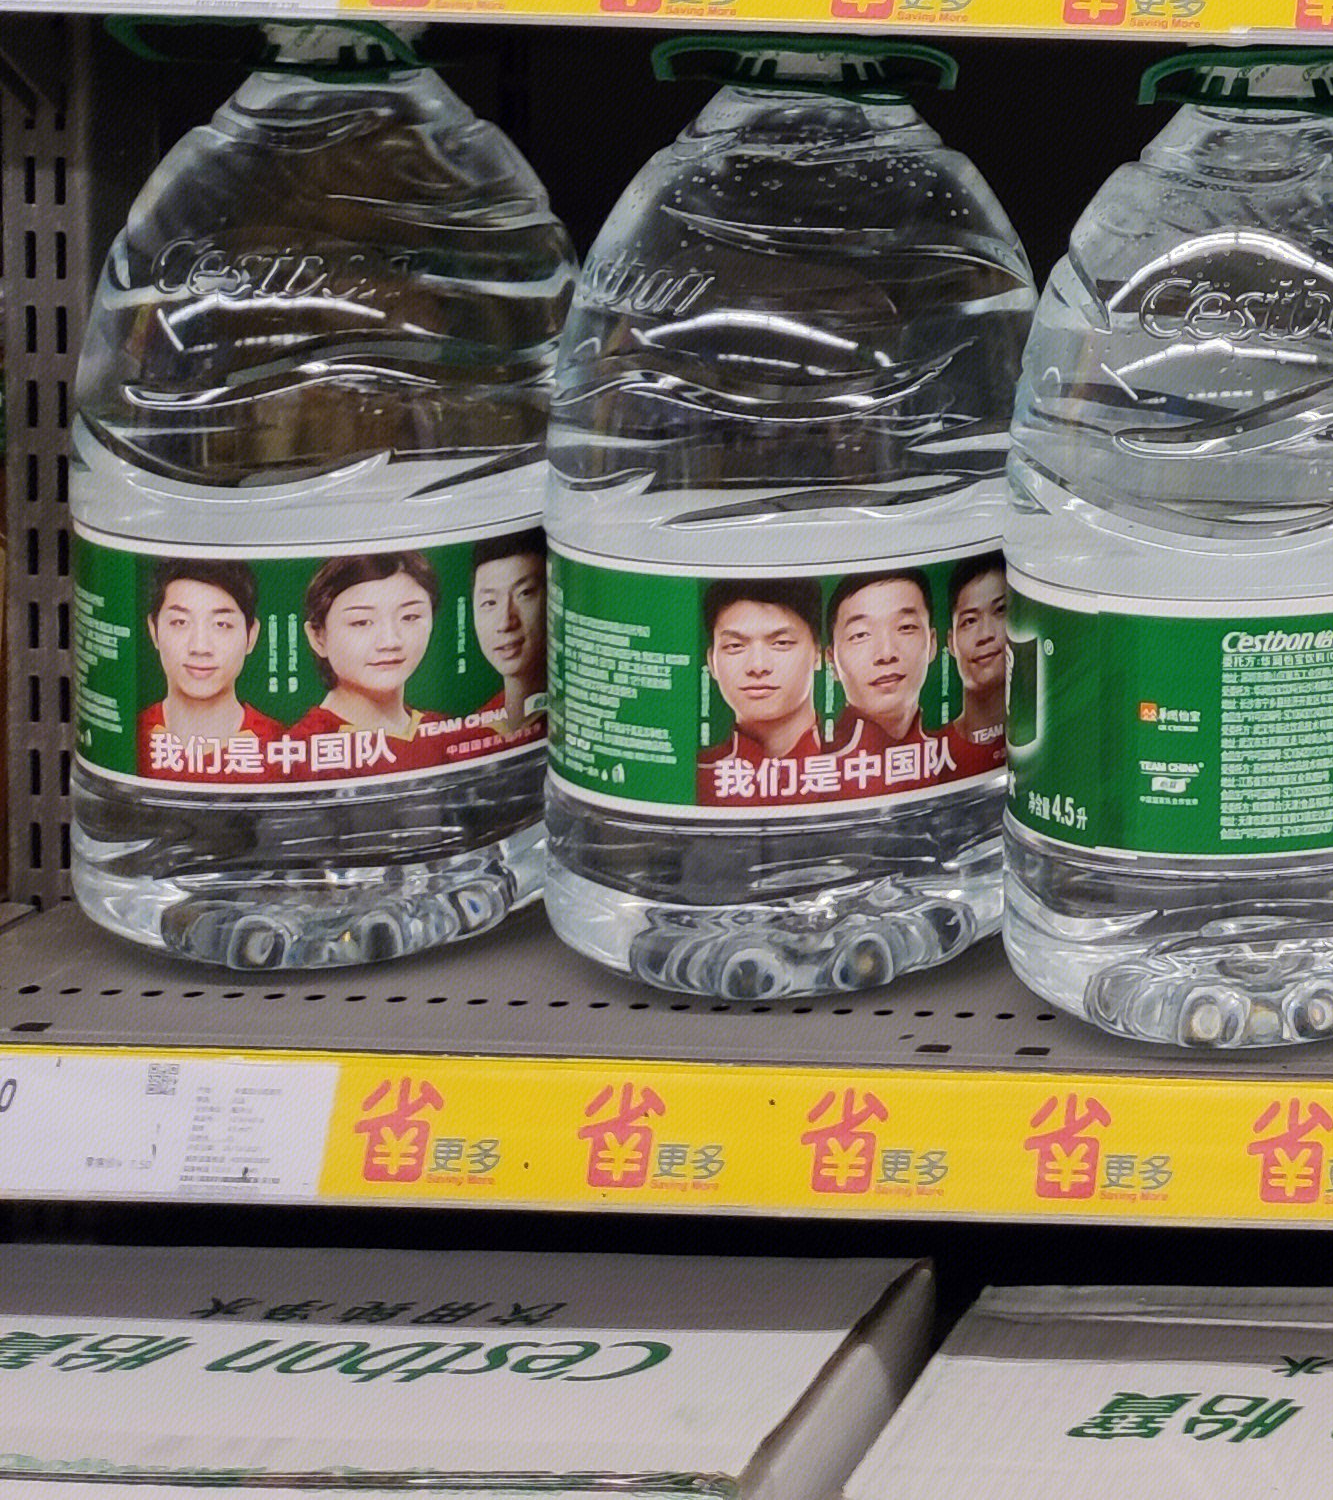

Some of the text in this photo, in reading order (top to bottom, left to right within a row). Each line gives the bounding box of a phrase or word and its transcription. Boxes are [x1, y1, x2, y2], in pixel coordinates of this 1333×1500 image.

[149, 728, 398, 775] 我们是中国队
[418, 707, 508, 738] TEAM CHINA
[713, 736, 958, 798] 我们是中国队
[357, 1079, 442, 1182] 省
[429, 1137, 501, 1174] 更多
[580, 1085, 724, 1188] 省 更多
[1025, 1095, 1173, 1199] 省 更多
[190, 1295, 568, 1328] 饮用纯净水
